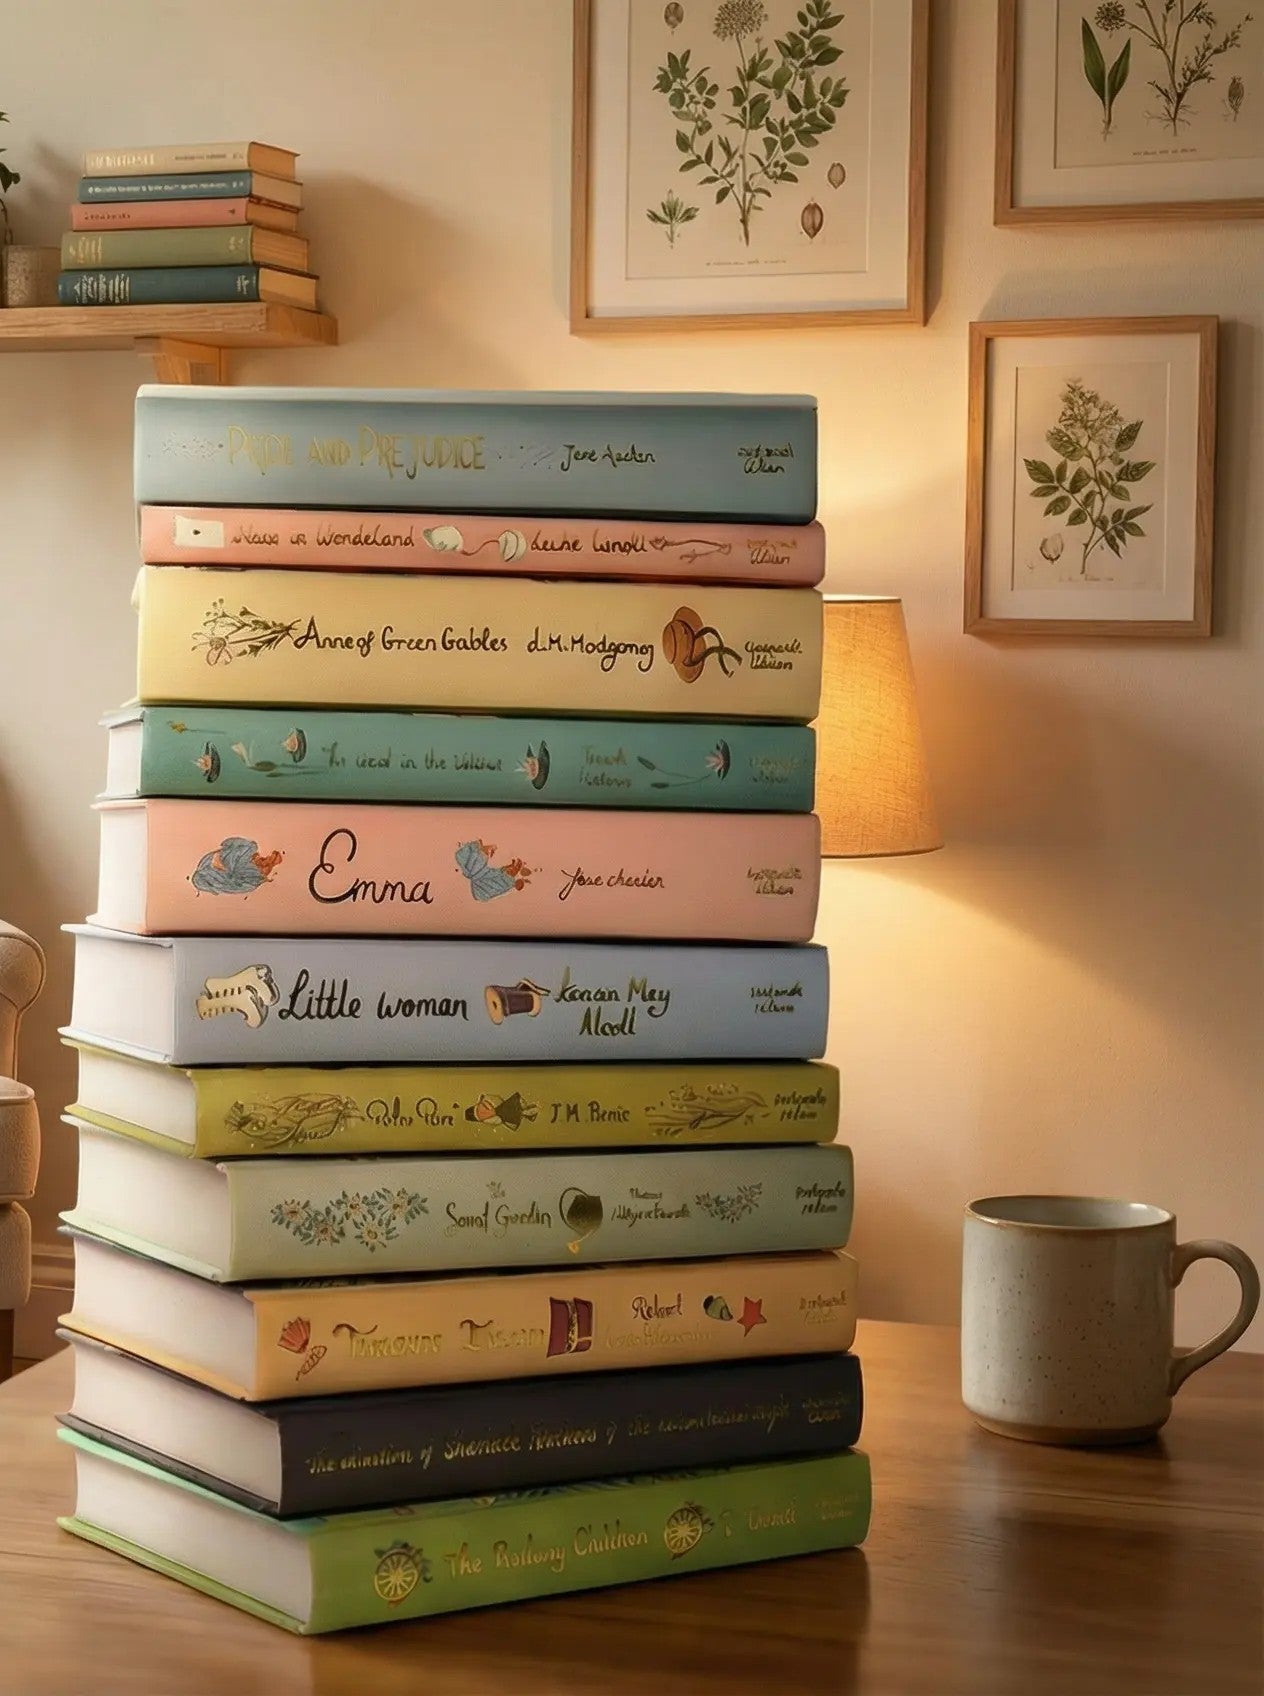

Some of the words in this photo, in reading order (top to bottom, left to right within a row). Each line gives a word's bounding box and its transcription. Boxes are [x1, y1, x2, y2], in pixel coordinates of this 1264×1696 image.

[381, 626, 436, 651] Green
[440, 626, 508, 651] Gables
[308, 827, 435, 905] Emma
[277, 968, 362, 1021] Little
[444, 1541, 483, 1579] The
